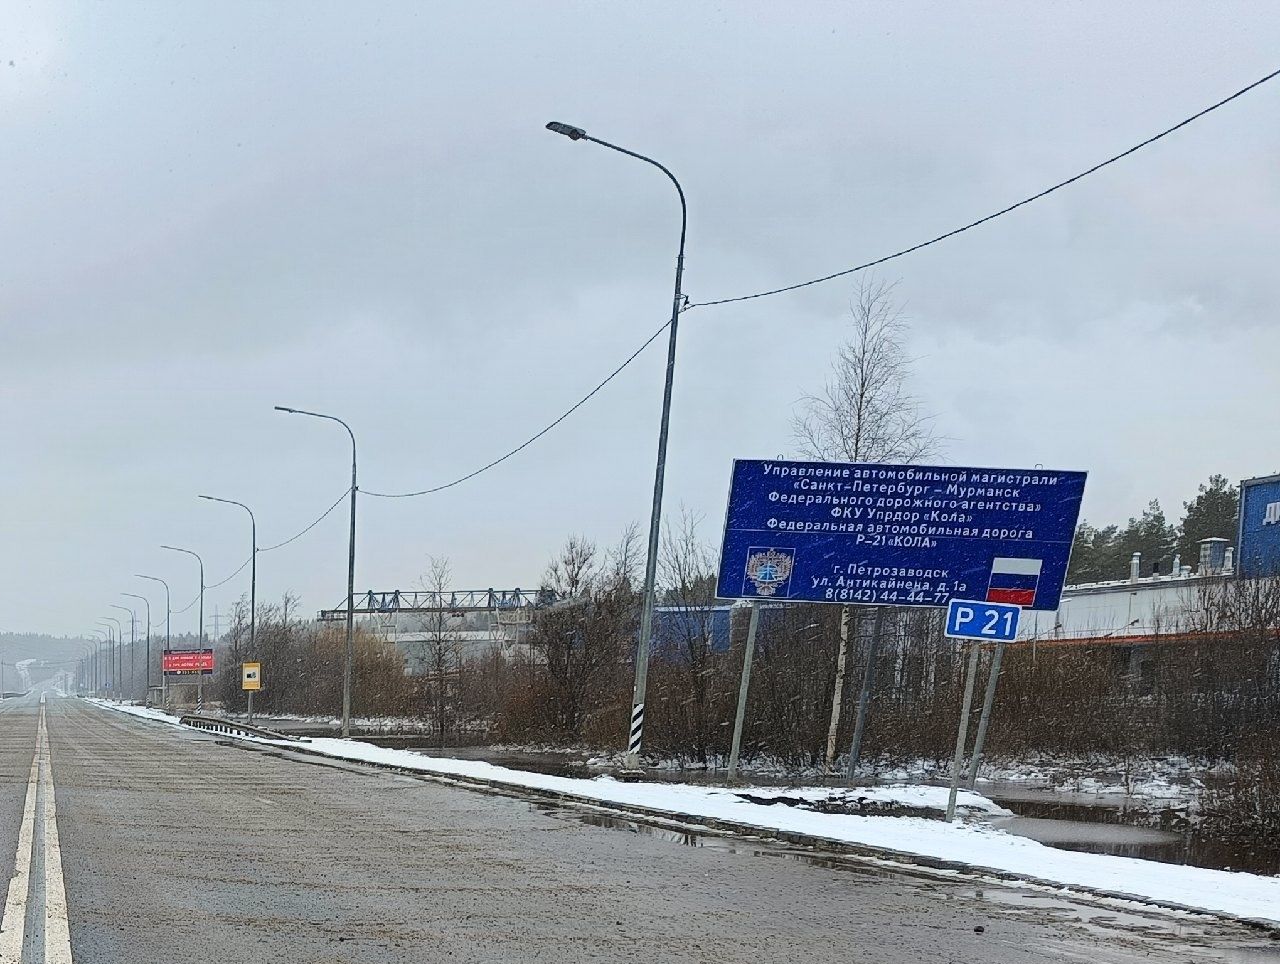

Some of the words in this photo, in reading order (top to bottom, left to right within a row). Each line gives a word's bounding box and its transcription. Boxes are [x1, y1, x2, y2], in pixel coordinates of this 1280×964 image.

[763, 463, 850, 478] Управление
[854, 468, 967, 482] автомобильной
[970, 473, 1058, 487] магистрали
[946, 483, 1021, 498] Мурманск
[768, 491, 873, 507] Федерального
[876, 497, 957, 510] дорожного
[961, 499, 1041, 513] агентства»
[830, 506, 863, 519] ФКУ
[867, 507, 920, 523] Упрдор
[923, 510, 973, 523] «Кола»
[766, 517, 864, 533] Федеральная
[867, 522, 979, 537] автомобильная
[981, 527, 1033, 540] дорога
[847, 563, 949, 578] Петрозаводск
[811, 575, 832, 589] ул.
[835, 576, 933, 591] Антикайнена,
[936, 582, 950, 592] д.
[953, 580, 967, 592] 1а
[825, 587, 877, 602] 8(8142)
[880, 590, 950, 604] 44-44-77
[954, 606, 974, 631] Р
[980, 609, 1013, 636] 21
